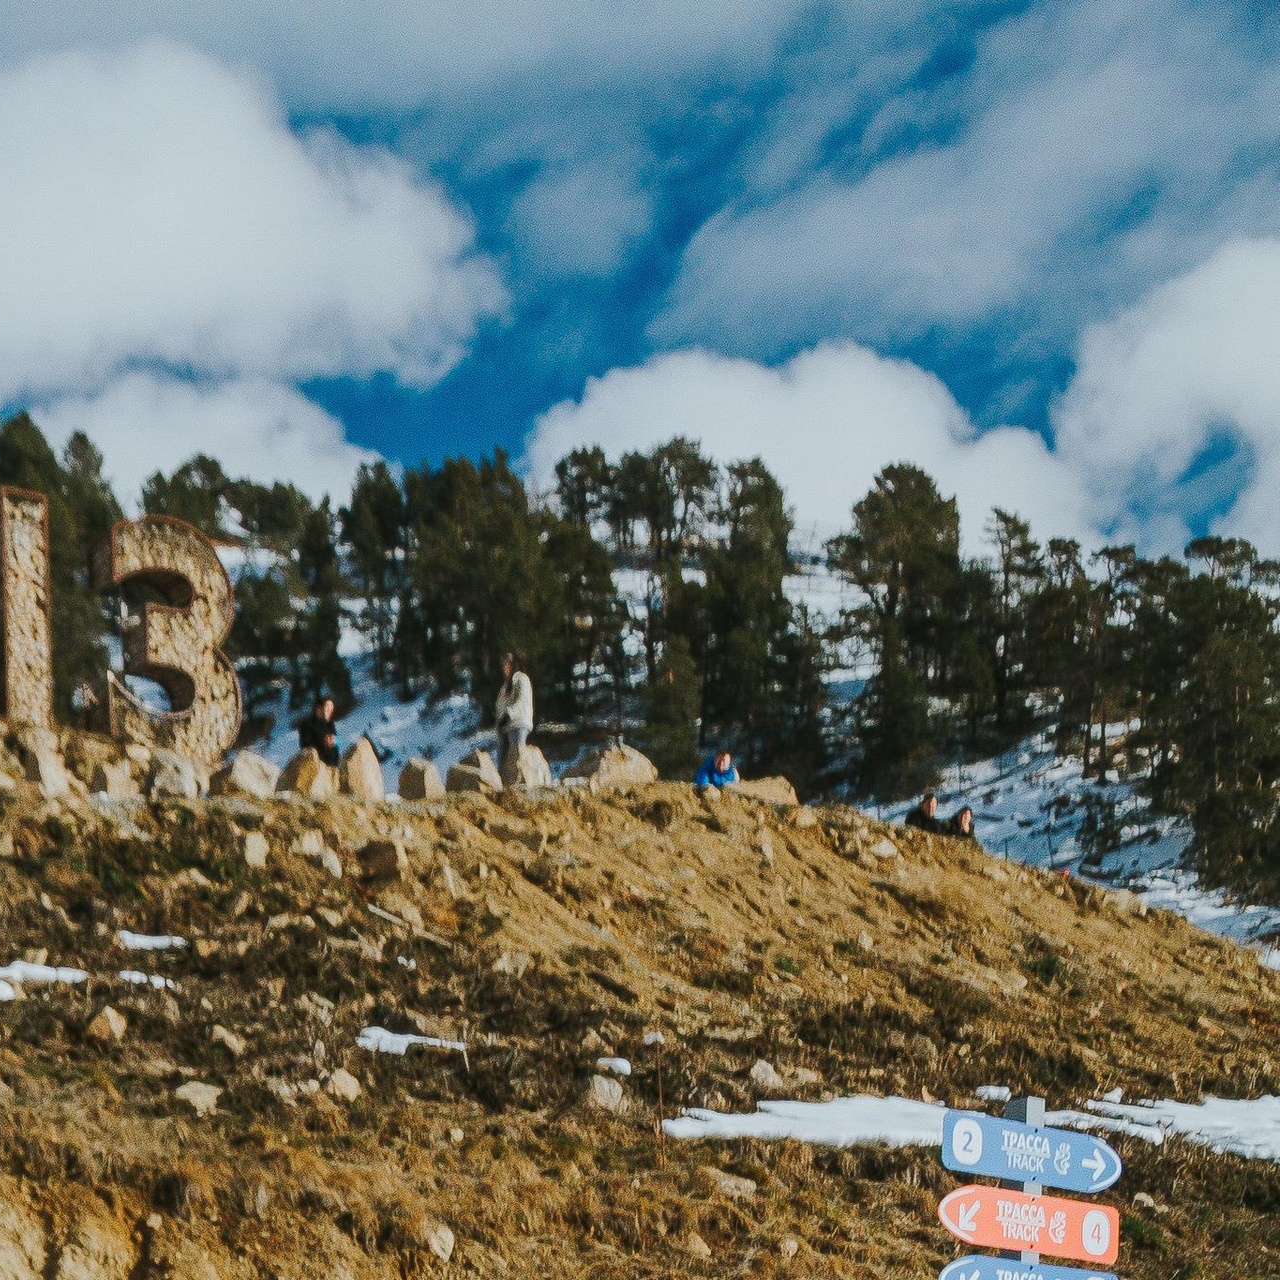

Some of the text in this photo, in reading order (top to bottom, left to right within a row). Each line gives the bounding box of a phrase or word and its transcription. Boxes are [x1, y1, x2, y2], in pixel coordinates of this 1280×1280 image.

[961, 1131, 974, 1153] 2
[1006, 1153, 1045, 1174] TRACK
[1001, 1221, 1040, 1243] TRACK
[1091, 1223, 1102, 1245] 4
